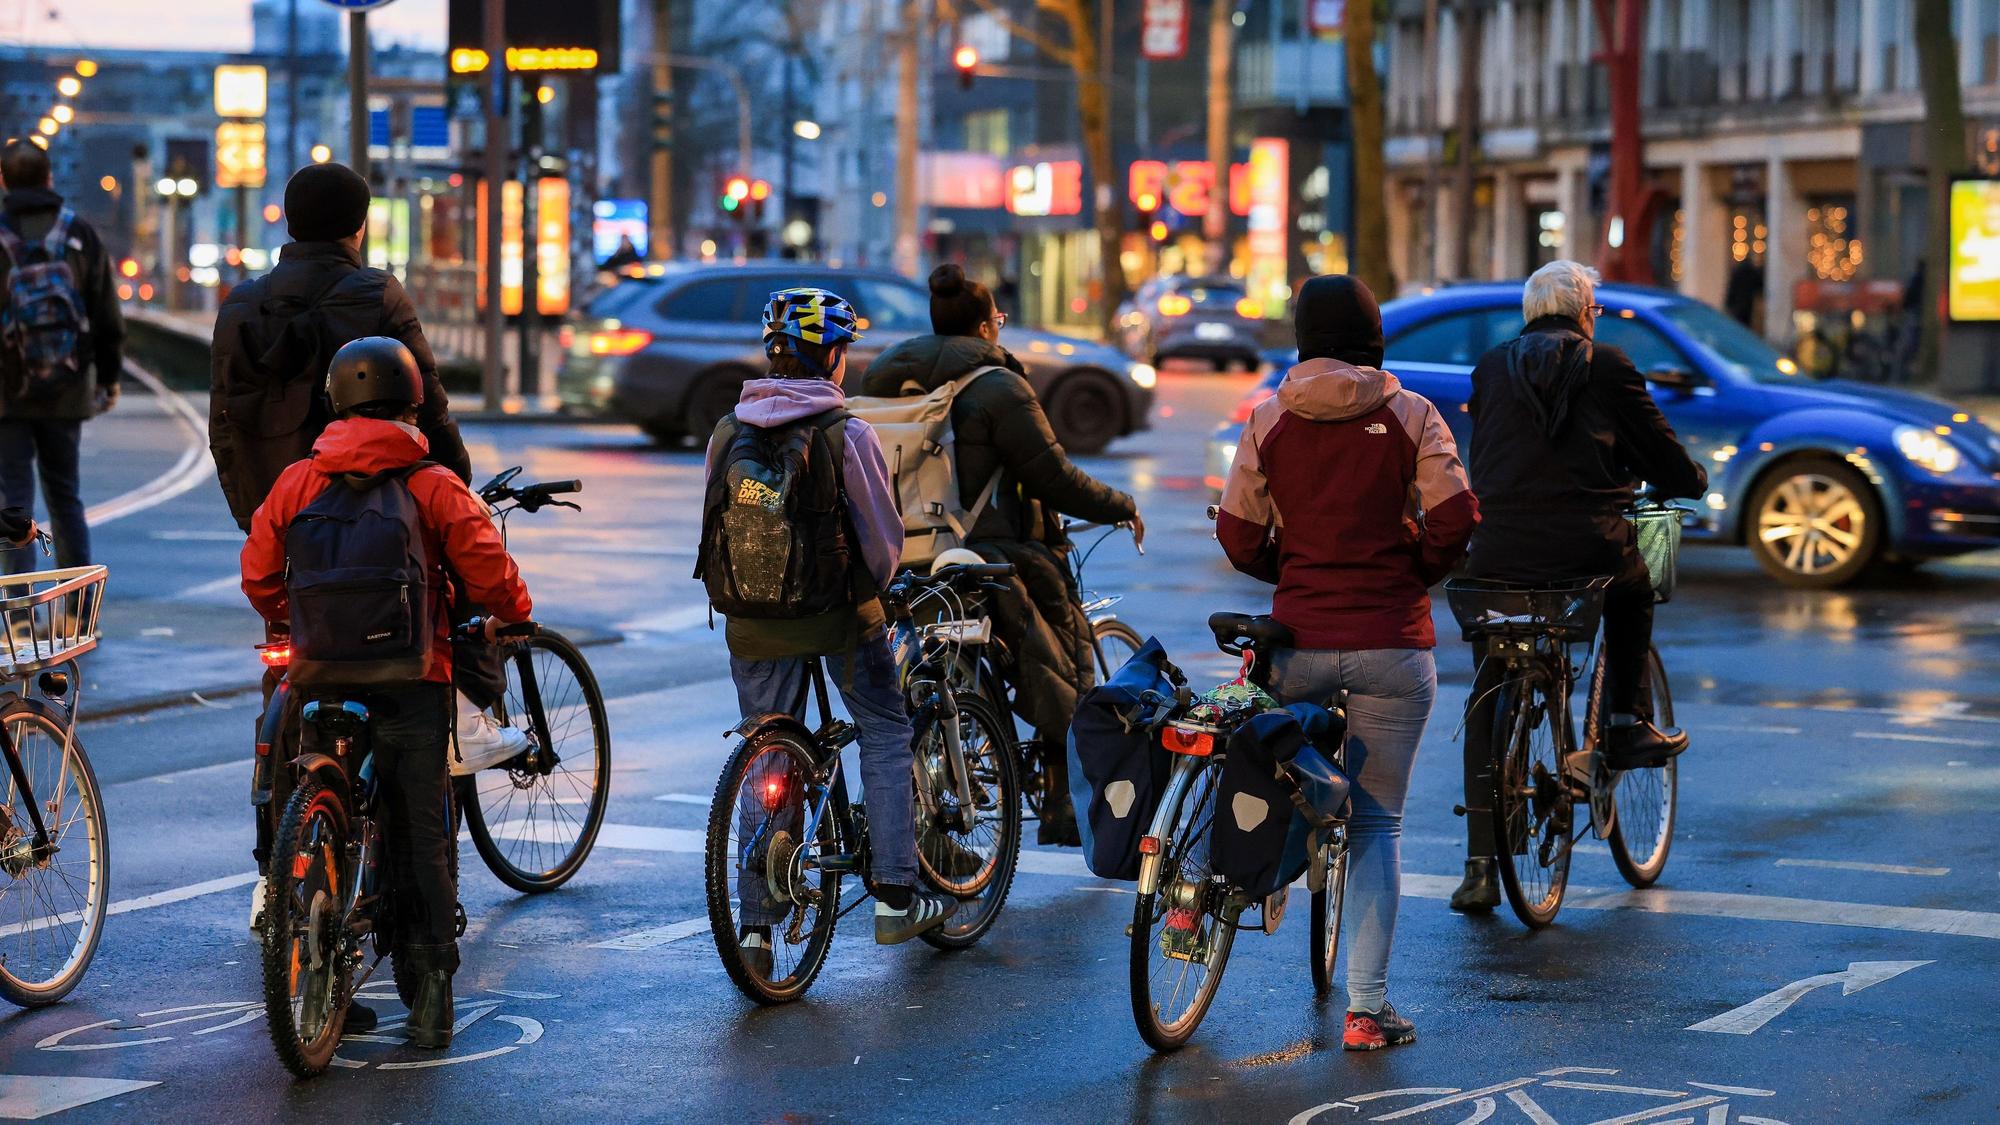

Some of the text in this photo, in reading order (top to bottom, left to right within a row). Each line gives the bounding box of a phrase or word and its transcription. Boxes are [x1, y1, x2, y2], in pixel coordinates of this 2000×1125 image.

[738, 488, 763, 500] DRY
[741, 478, 781, 499] SUPER
[366, 632, 391, 640] EASTPAK
